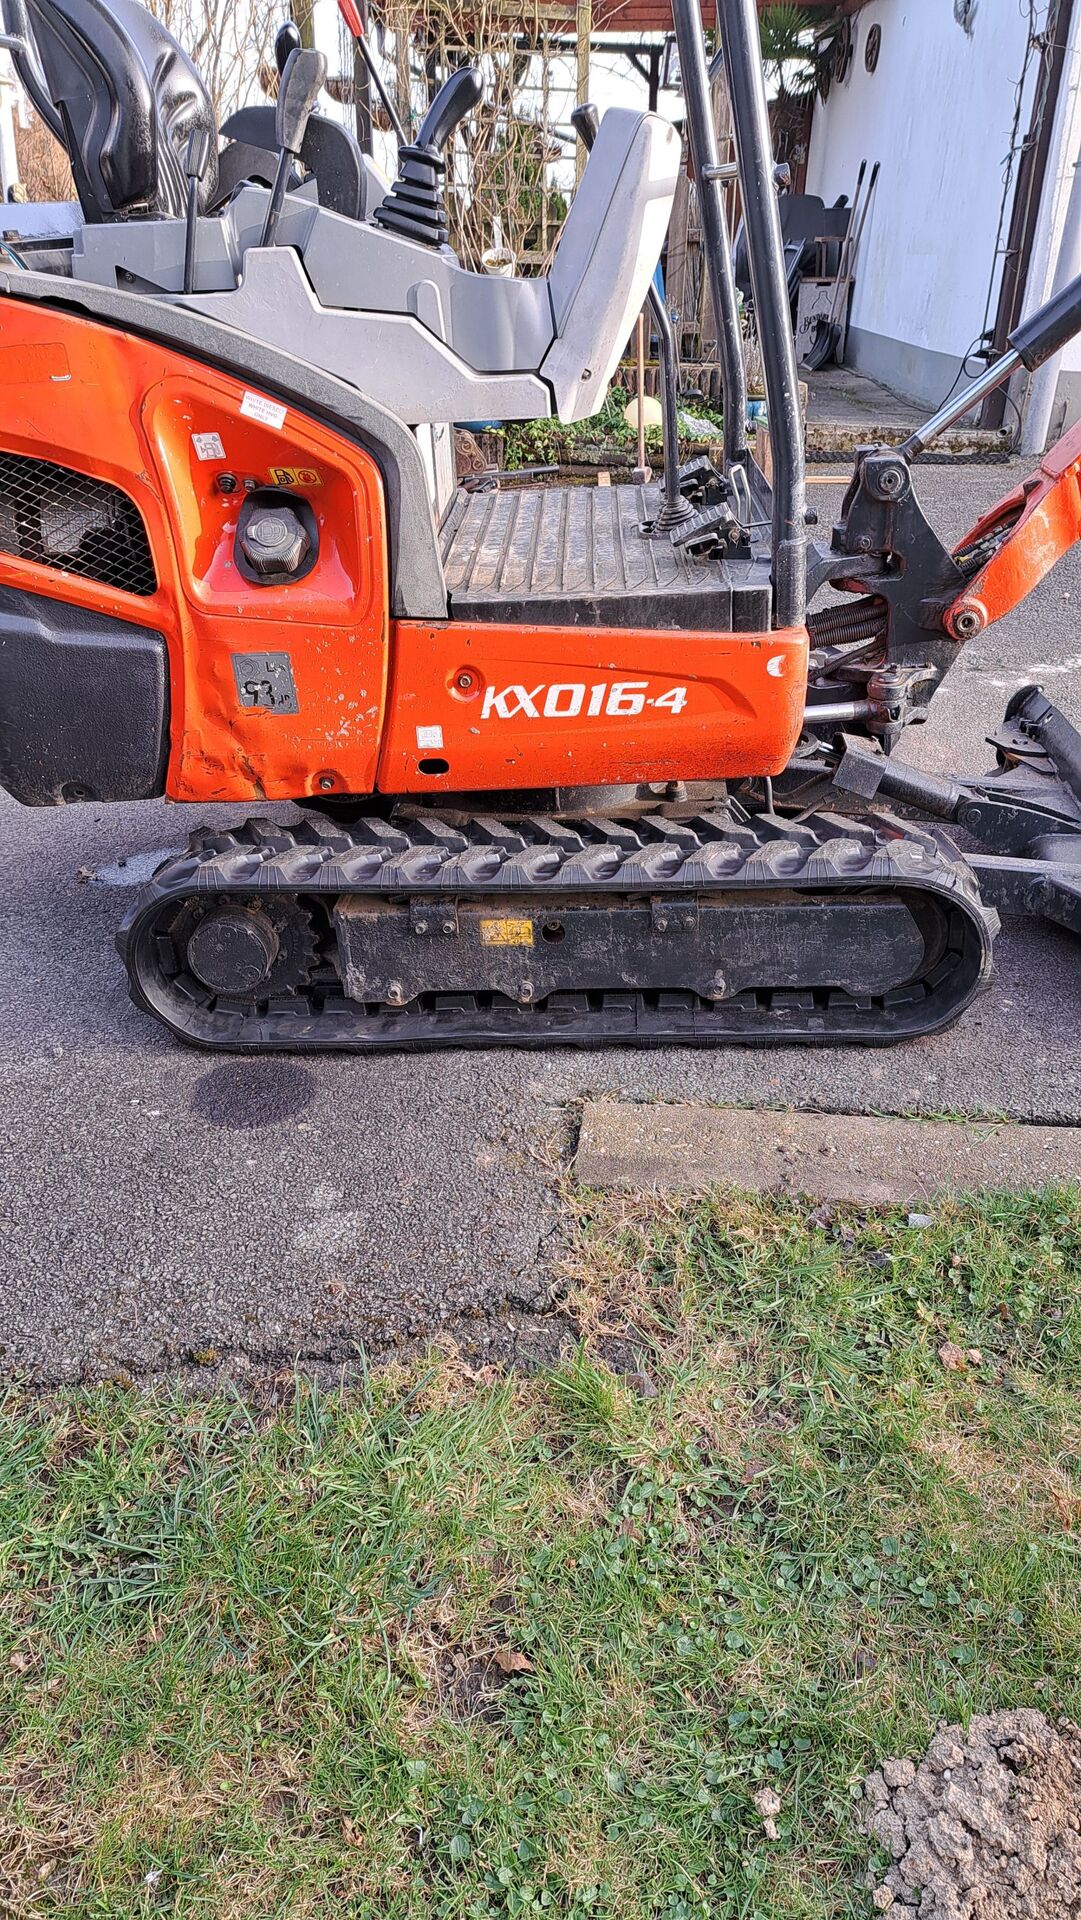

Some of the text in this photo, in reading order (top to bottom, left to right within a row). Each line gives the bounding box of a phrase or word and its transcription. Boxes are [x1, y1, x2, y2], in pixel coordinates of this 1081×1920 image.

[245, 395, 263, 405] WHITE
[248, 402, 265, 414] WHITE
[253, 412, 269, 421] ONLY
[480, 681, 688, 719] KX016-4
